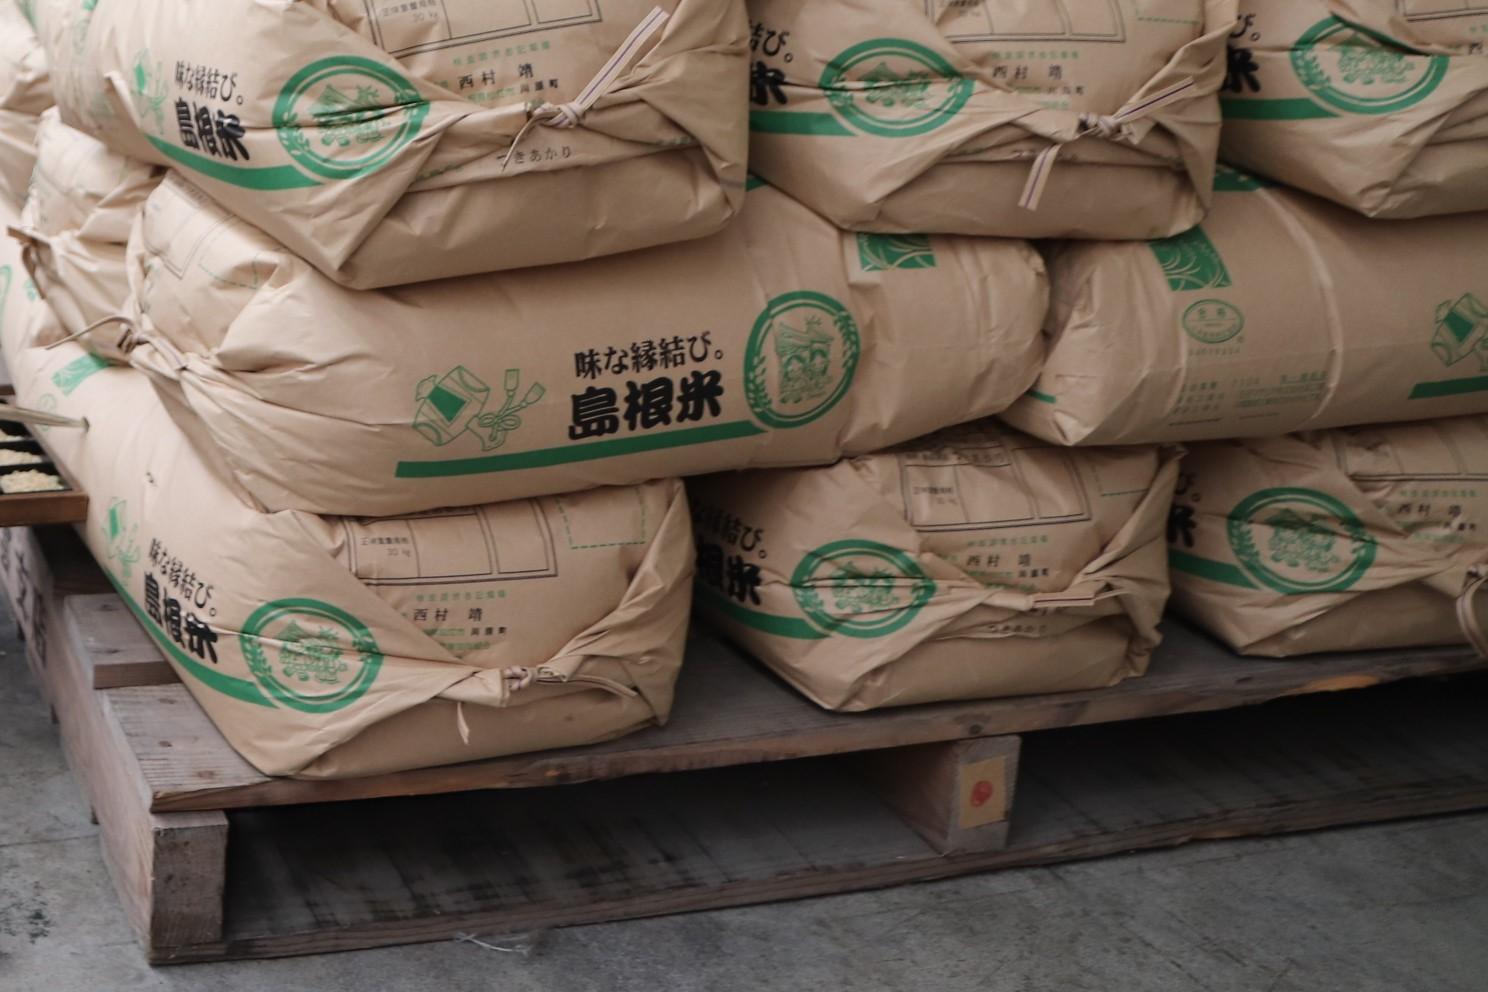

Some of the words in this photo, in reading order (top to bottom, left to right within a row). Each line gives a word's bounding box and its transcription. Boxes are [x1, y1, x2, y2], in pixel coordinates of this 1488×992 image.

[175, 60, 245, 106] 味な縁結び。
[174, 96, 251, 161] 島根米
[574, 330, 726, 381] 味な縁結び。
[568, 369, 725, 441] 島根米
[413, 607, 449, 622] 西村
